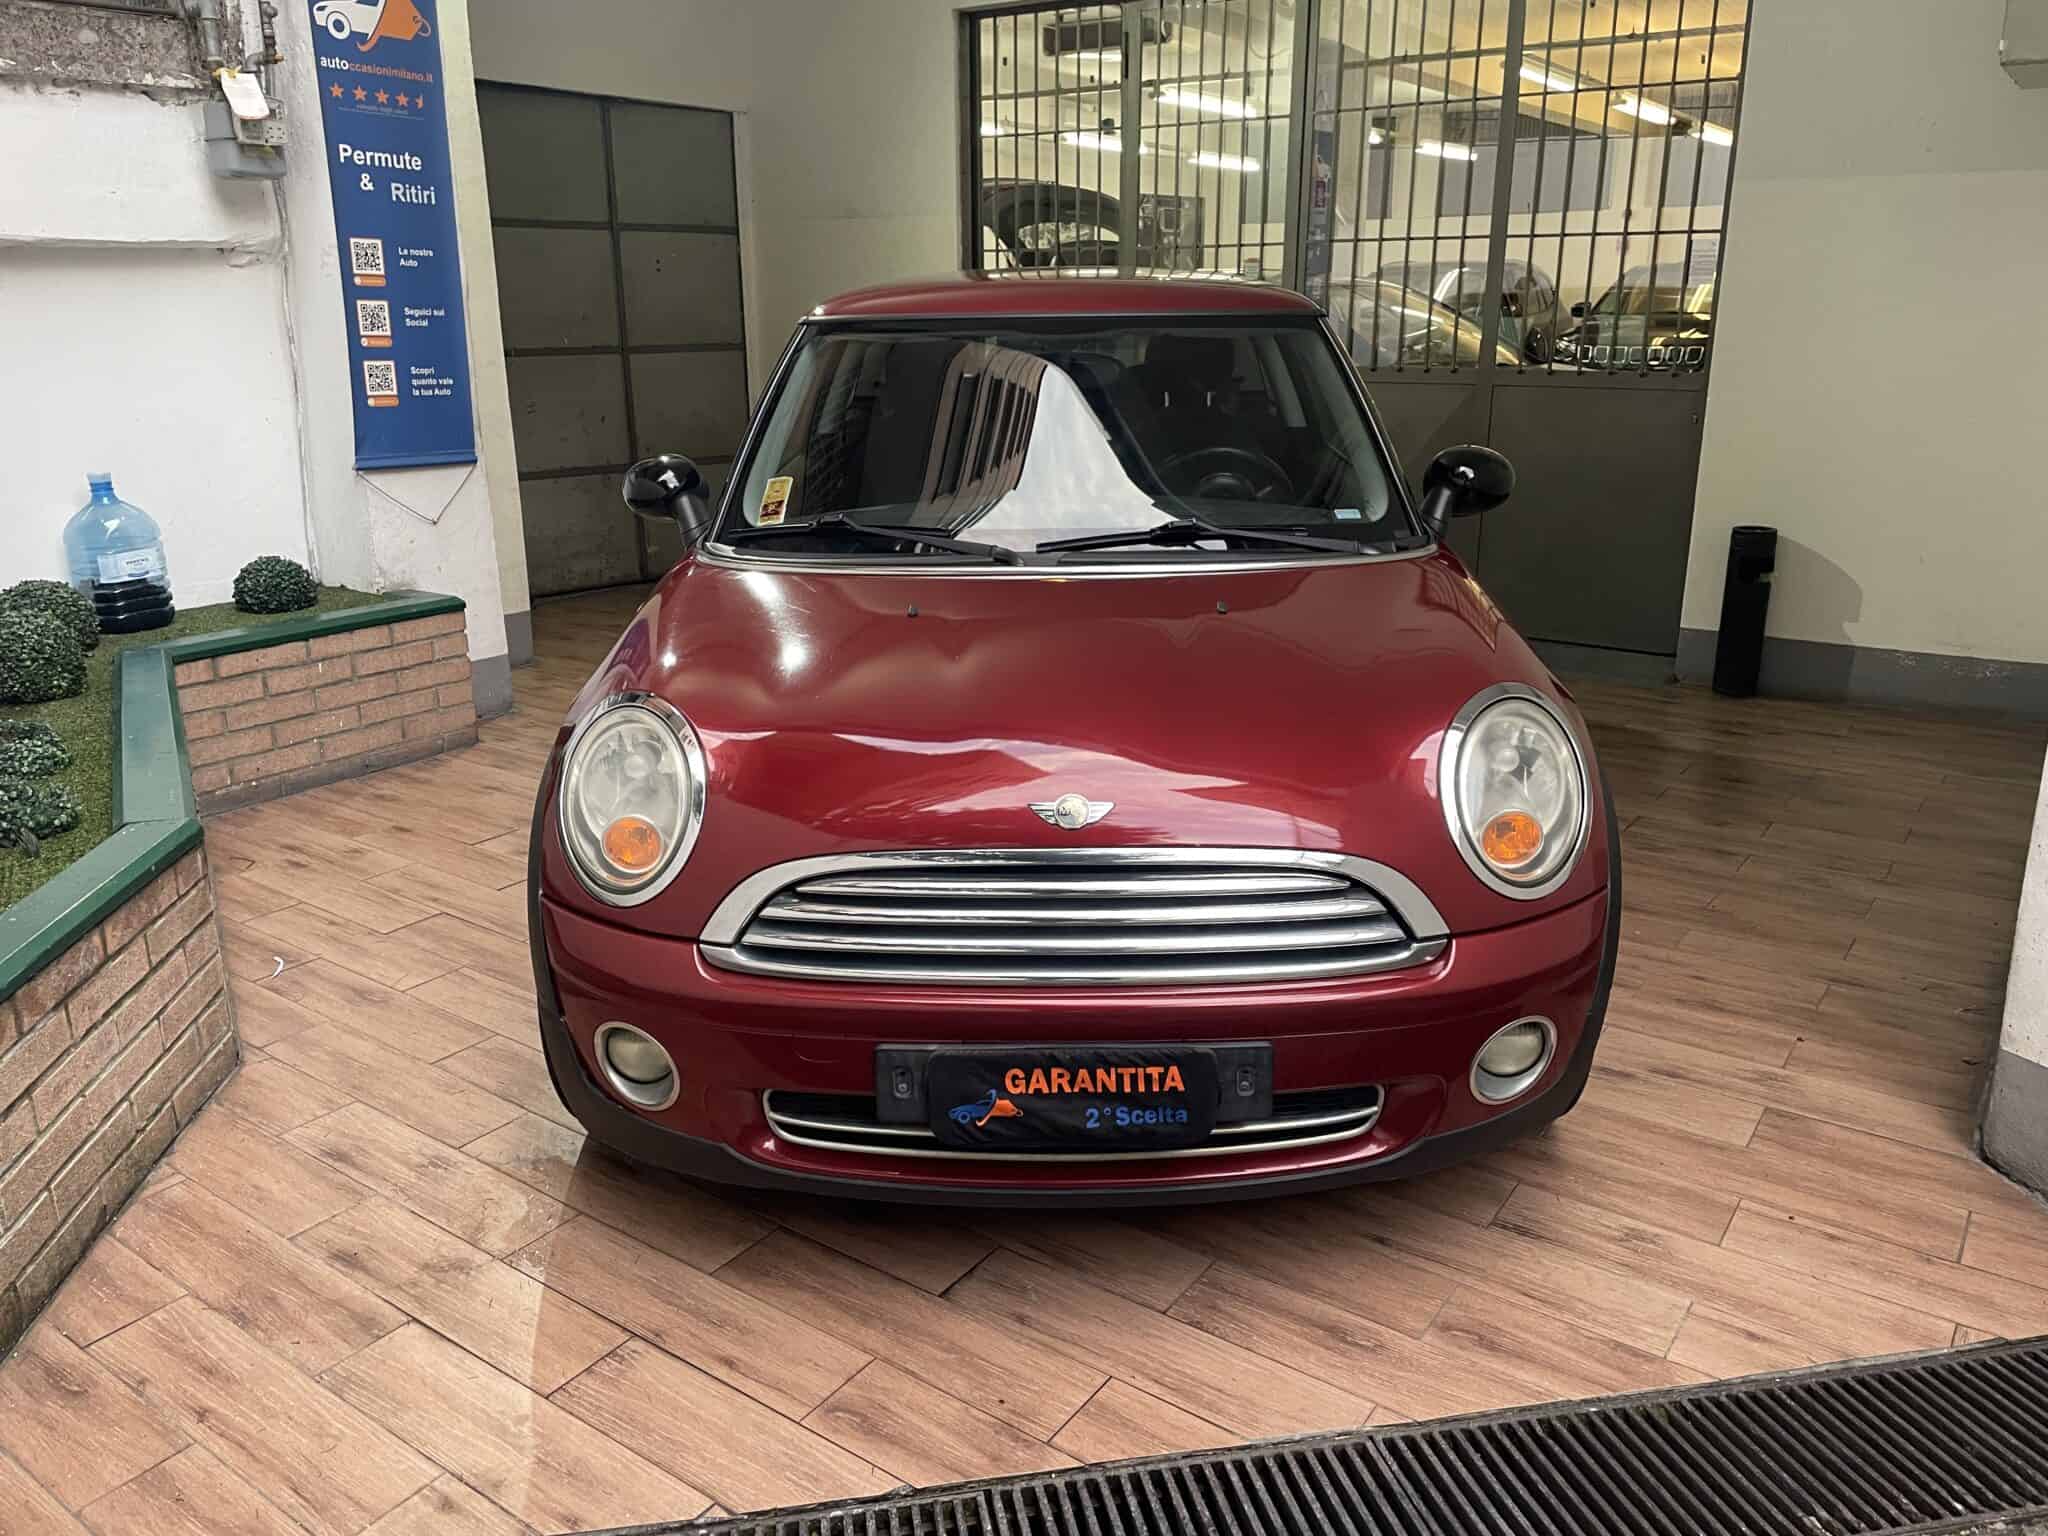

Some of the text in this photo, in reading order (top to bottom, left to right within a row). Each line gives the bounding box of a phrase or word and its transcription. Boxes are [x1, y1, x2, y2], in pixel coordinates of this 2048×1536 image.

[338, 143, 423, 171] Permute
[360, 173, 436, 205] & Ritiri
[399, 257, 418, 267] Auto
[404, 306, 431, 318] Seguici
[405, 318, 429, 327] Social
[410, 366, 435, 376] Scopri
[434, 387, 452, 396] Auto
[1004, 1065, 1186, 1095] GARANTITA
